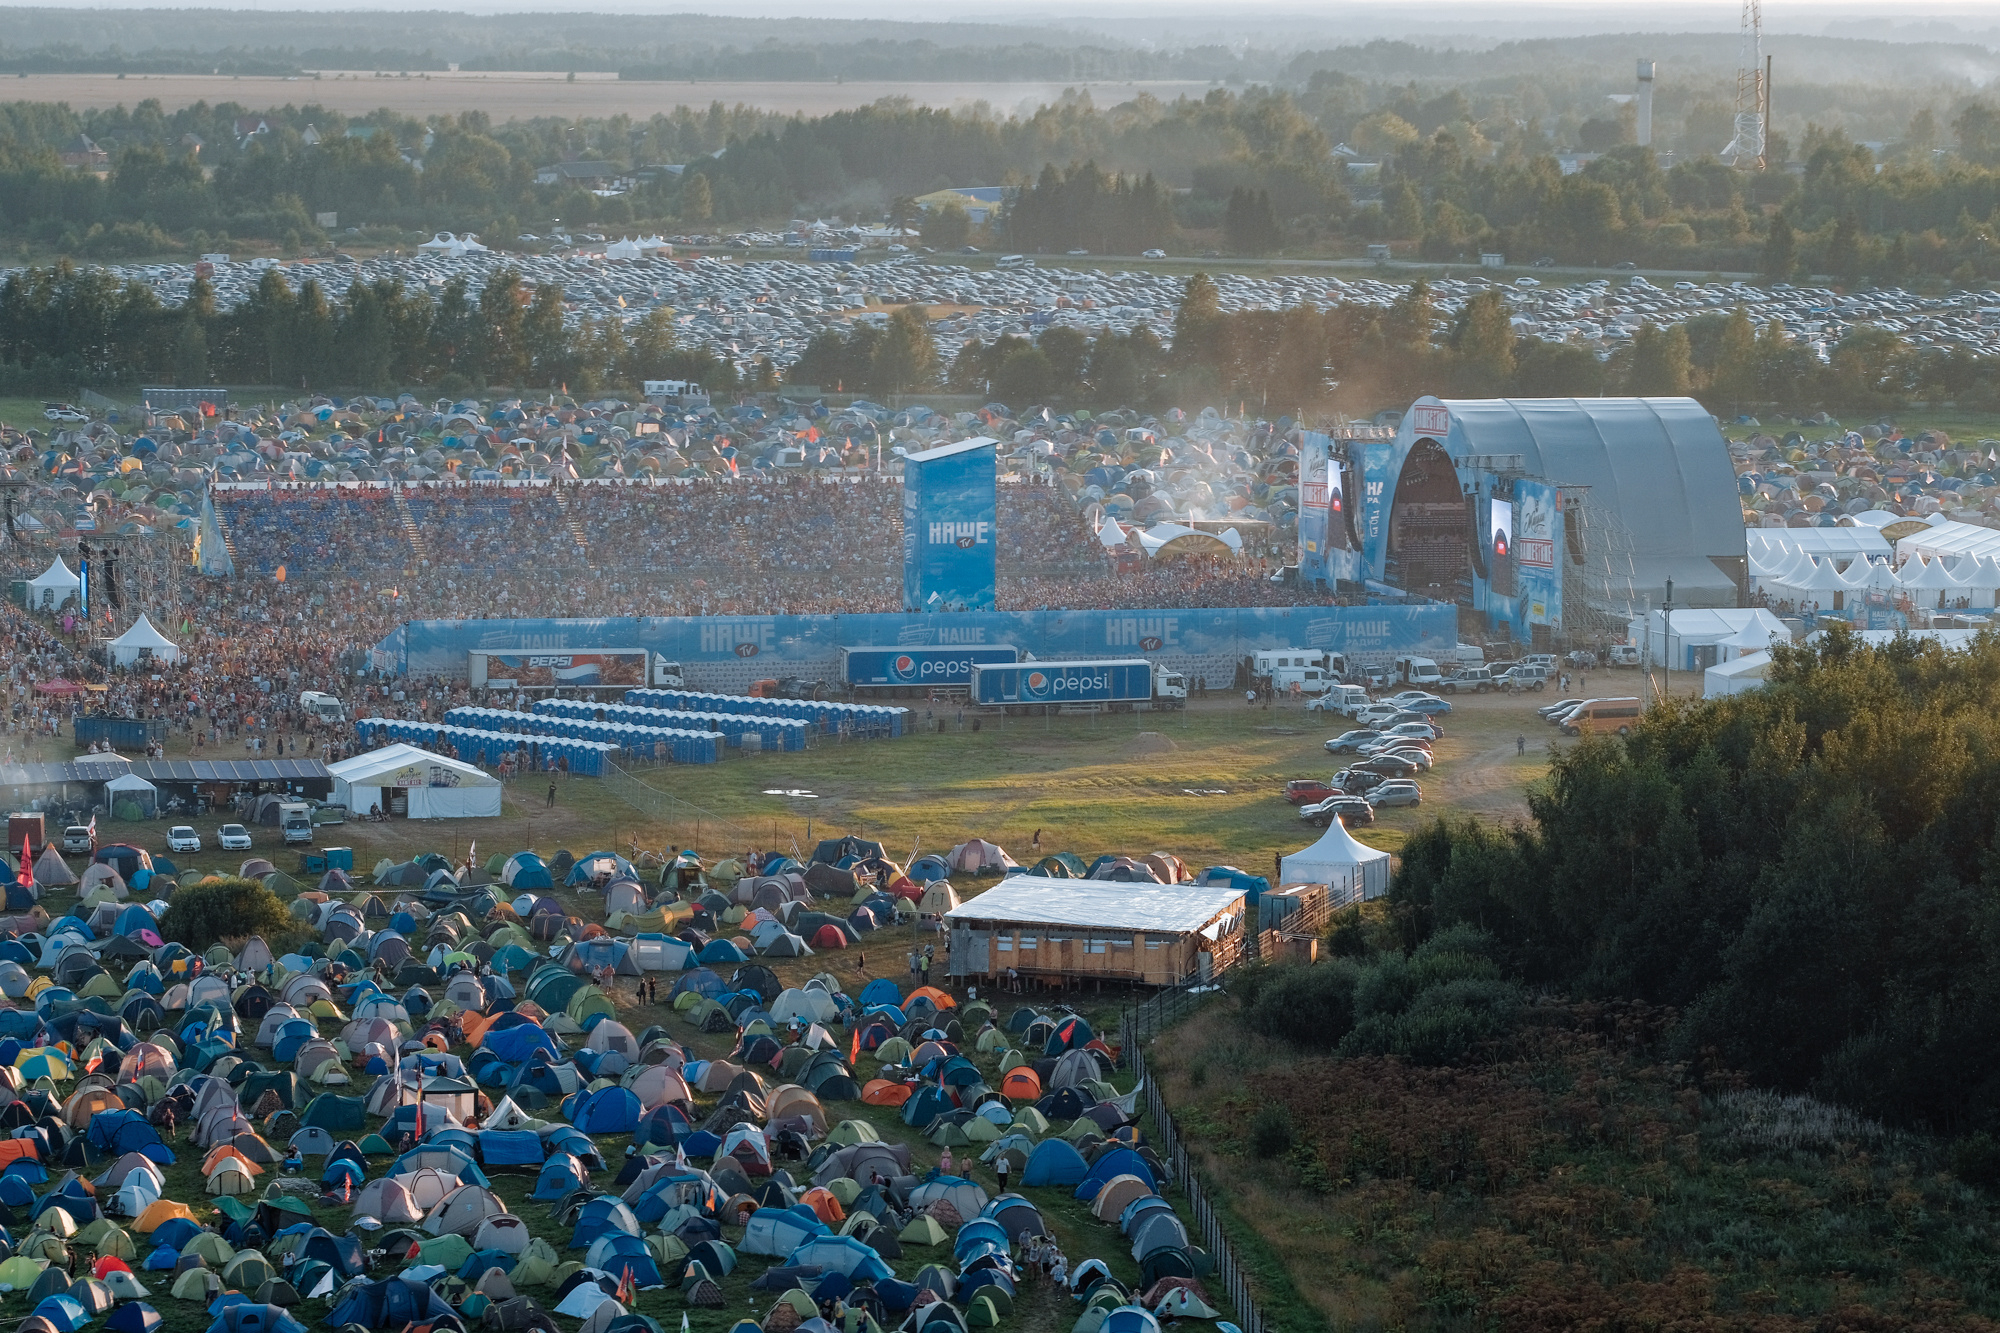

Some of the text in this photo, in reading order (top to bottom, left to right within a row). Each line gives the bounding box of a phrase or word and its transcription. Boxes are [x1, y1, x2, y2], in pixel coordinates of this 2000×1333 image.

[929, 521, 988, 544] НАШЕ
[959, 537, 972, 548] TV
[939, 627, 986, 644] НАШЕ
[1105, 618, 1179, 646] НАШЕ
[1345, 620, 1391, 637] НАШЕ
[521, 633, 568, 650] НАШЕ
[701, 624, 775, 652] НАШЕ
[1143, 638, 1159, 651] TV
[1346, 638, 1382, 647] РАДИО
[739, 644, 754, 657] TV
[528, 656, 574, 668] PEPSI
[1053, 672, 1109, 695] pepsi
